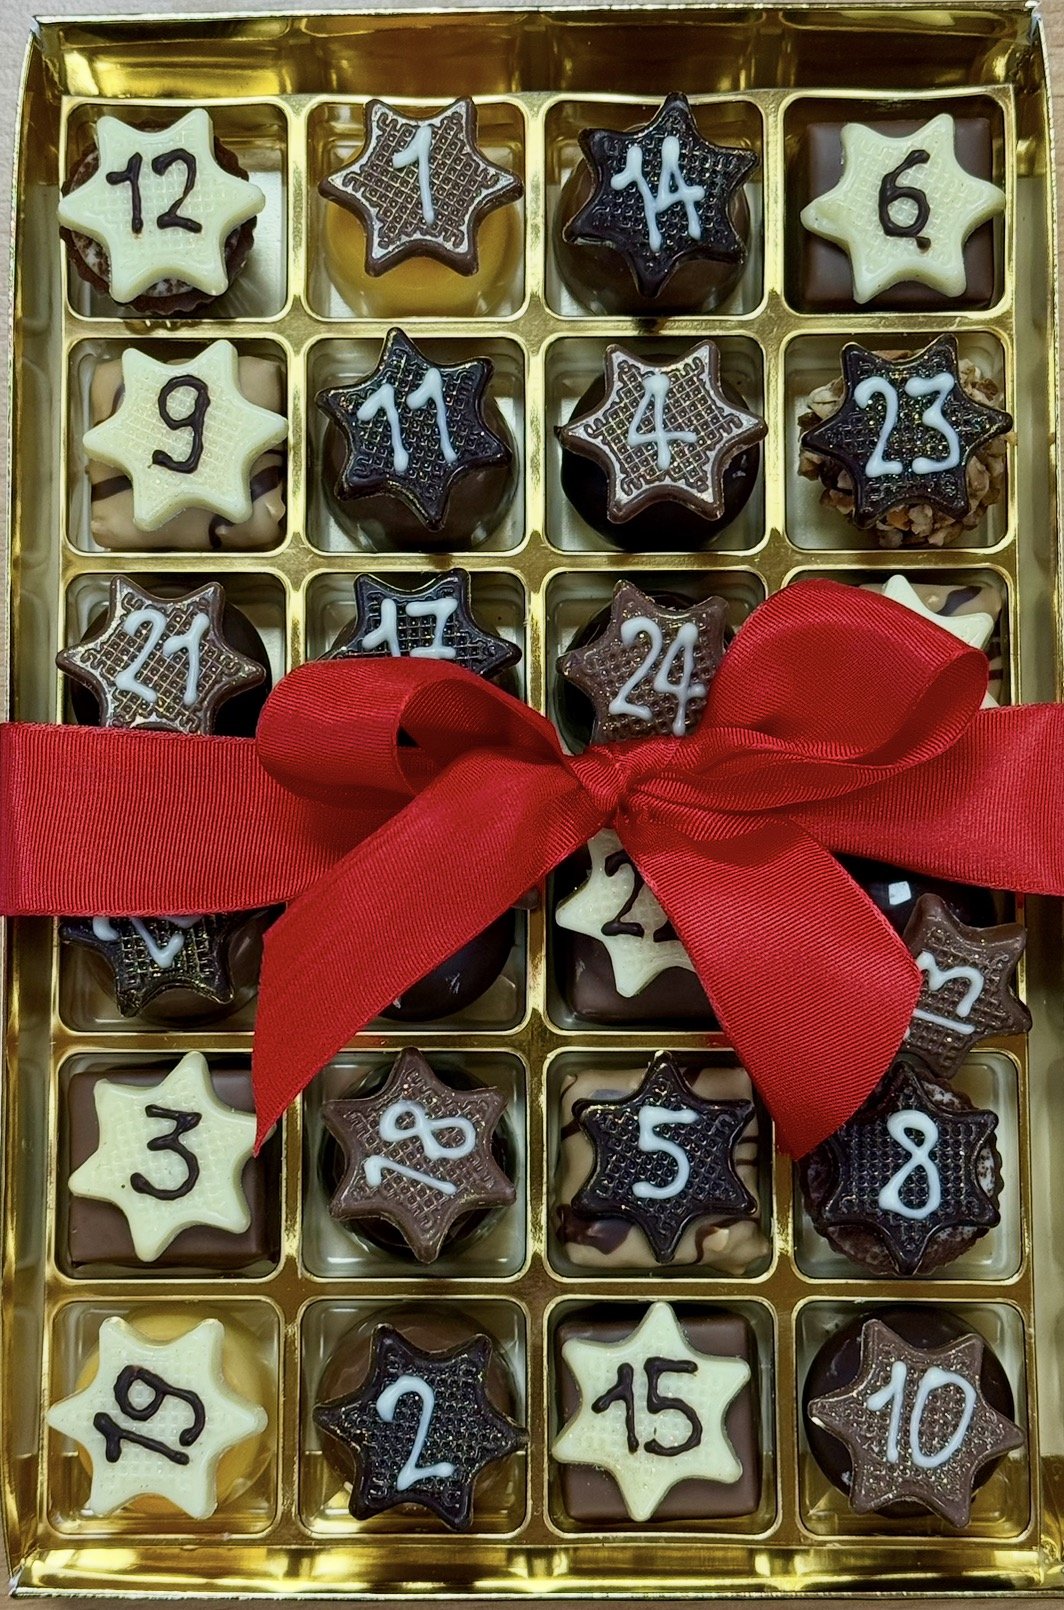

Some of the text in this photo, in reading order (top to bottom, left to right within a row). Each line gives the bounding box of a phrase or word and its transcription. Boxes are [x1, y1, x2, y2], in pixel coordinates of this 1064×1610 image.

[105, 147, 203, 234] 12
[392, 124, 434, 225] 1
[611, 135, 705, 252] 14
[878, 149, 931, 251] 6
[151, 374, 211, 474] 9
[357, 367, 458, 473] 11
[627, 374, 697, 471] 4
[854, 372, 961, 478] 23
[115, 608, 210, 706] 21
[608, 616, 706, 736] 24
[130, 1104, 202, 1200] 3
[364, 1100, 476, 1196] 18
[632, 1105, 698, 1199] 5
[878, 1109, 942, 1220] 8
[93, 1364, 206, 1465] 19
[376, 1375, 456, 1491] 2
[592, 1356, 702, 1456] 15
[866, 1361, 977, 1468] 10
